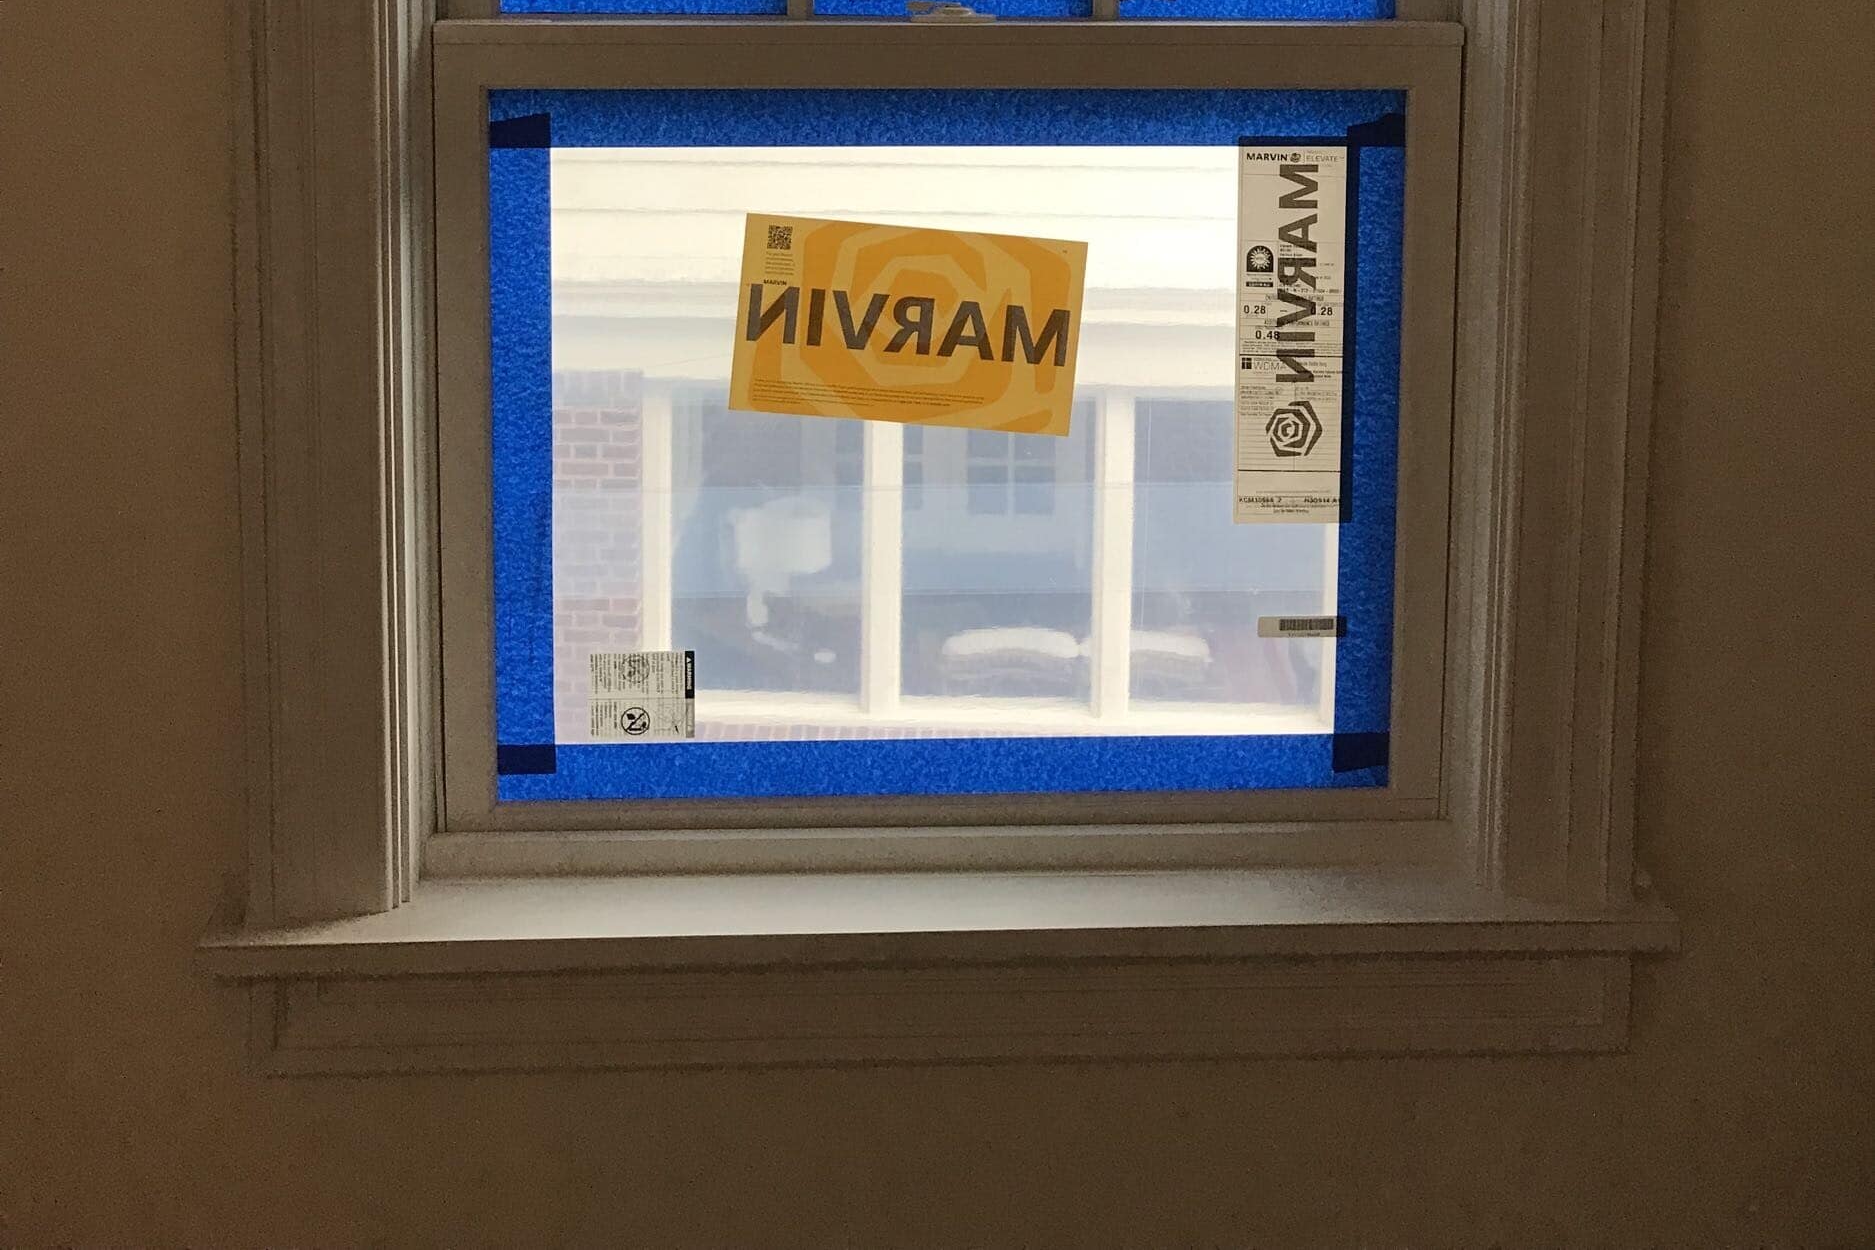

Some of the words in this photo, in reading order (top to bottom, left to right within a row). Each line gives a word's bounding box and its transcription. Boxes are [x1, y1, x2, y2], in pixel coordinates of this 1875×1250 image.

[1246, 152, 1288, 162] MARVIN
[1243, 304, 1266, 315] 0.28
[1310, 306, 1333, 316] 0.28
[1255, 330, 1280, 341] 0.48
